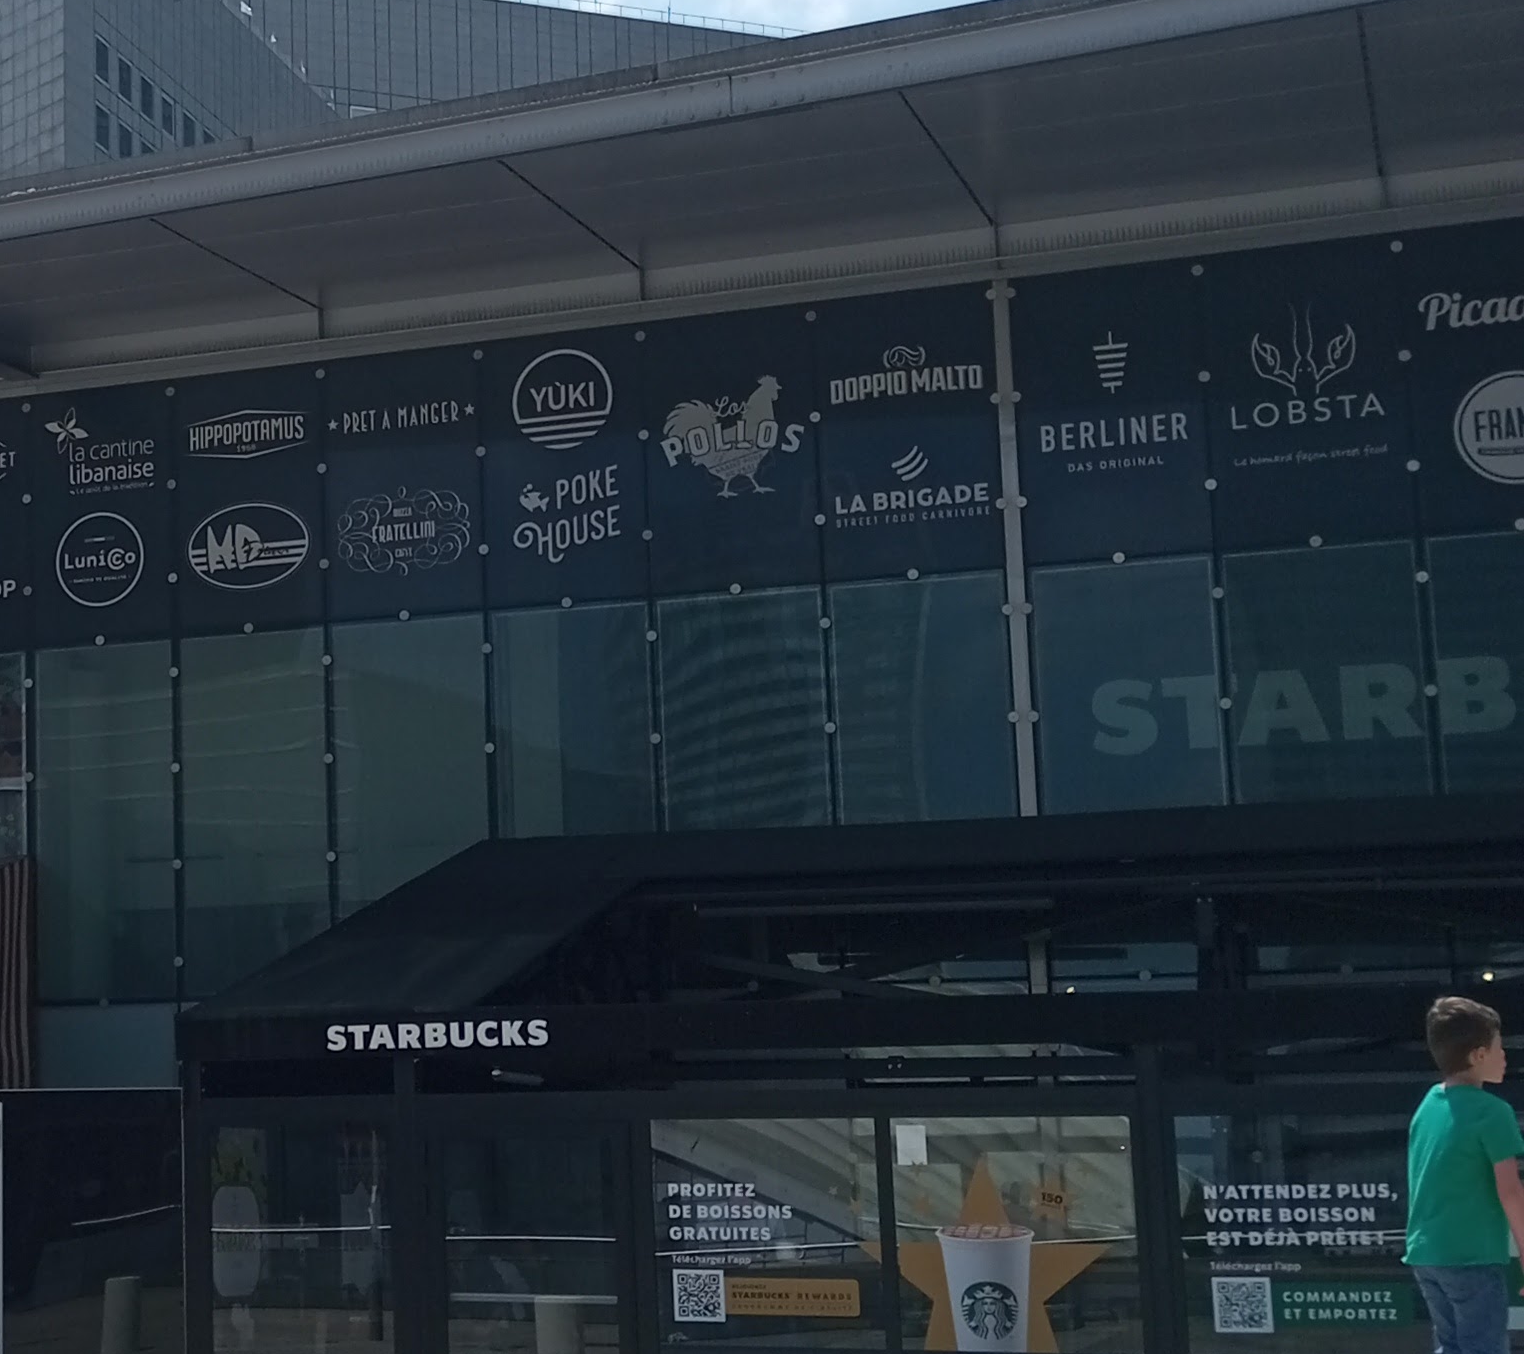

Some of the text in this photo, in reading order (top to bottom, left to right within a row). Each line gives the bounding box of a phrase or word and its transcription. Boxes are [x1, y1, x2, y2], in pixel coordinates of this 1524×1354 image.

[830, 364, 984, 405] DOPPIO MALTO
[343, 400, 459, 435] PRET A MANGER
[712, 395, 749, 418] Los
[1231, 392, 1385, 431] LOBSTA
[189, 415, 305, 452] HIPPOPOTAMUS
[660, 419, 805, 467] POLLOS
[1040, 412, 1188, 453] BERLINER
[69, 438, 155, 463] la cantine
[69, 459, 155, 485] libanaise
[1067, 455, 1164, 473] DAS ORIGINAL
[556, 464, 619, 509] POKE
[835, 482, 990, 515] LA BRIGADE
[836, 505, 991, 529] STREET FOOD CARNIVORE
[372, 520, 436, 544] FRATELLINI
[513, 504, 622, 563] HOUSE
[326, 1018, 549, 1051] STARBUCKS
[667, 1182, 756, 1198] PROFITEZ
[1203, 1182, 1399, 1202] N'ATTENDEZ PLUS,
[668, 1203, 792, 1221] DE BOISSONS
[1204, 1206, 1375, 1223] VOTRE BOISSON
[669, 1226, 772, 1242] GRATUITES
[1206, 1231, 1241, 1247] EST
[1249, 1227, 1299, 1247] DÉJÀ
[1307, 1227, 1372, 1247] PRÊTE
[1210, 1261, 1273, 1273] Téléchargez
[797, 1292, 852, 1301] REWARDS
[1282, 1291, 1393, 1304] COMMANDEZ
[1284, 1308, 1398, 1320] ET EMPORTEZ
